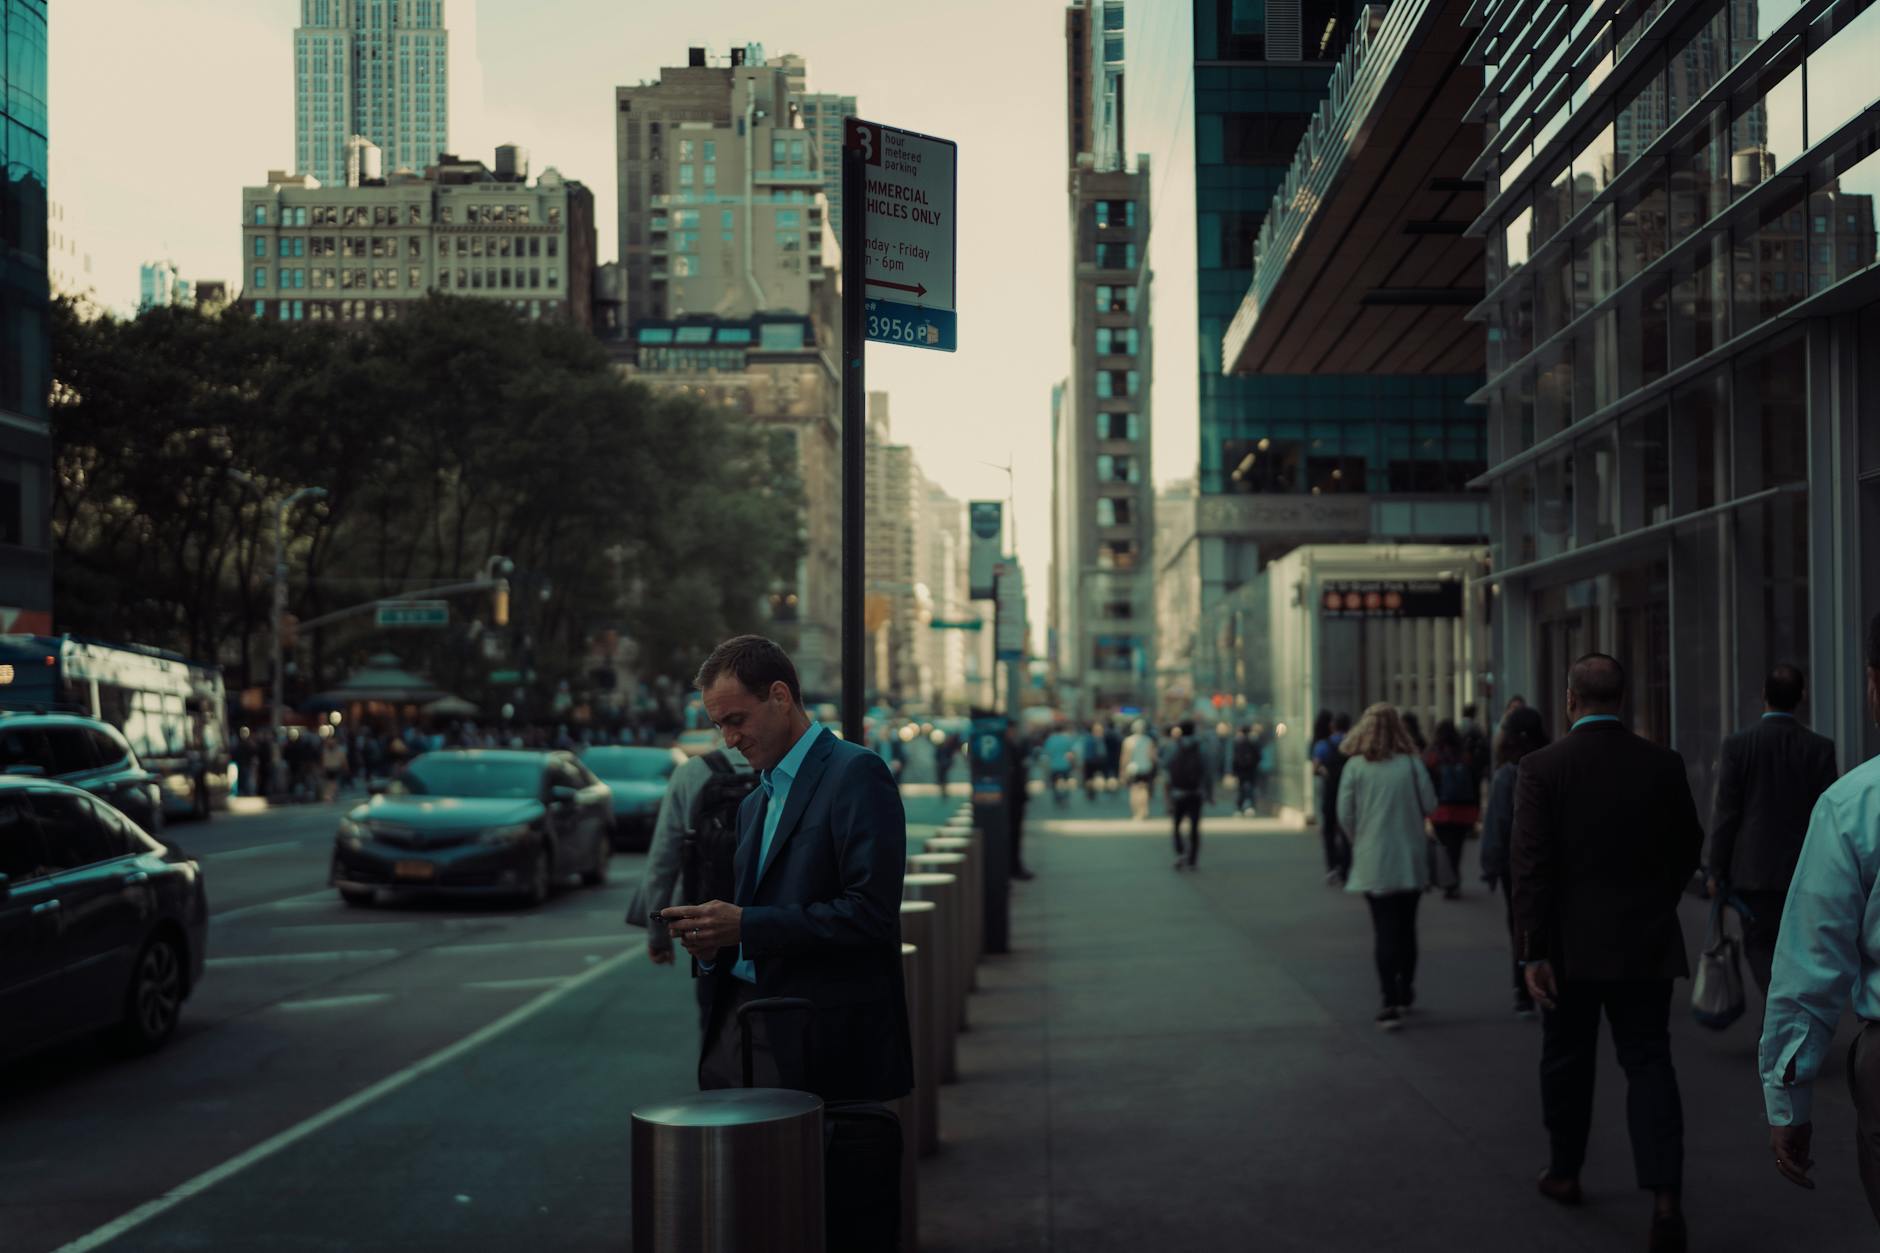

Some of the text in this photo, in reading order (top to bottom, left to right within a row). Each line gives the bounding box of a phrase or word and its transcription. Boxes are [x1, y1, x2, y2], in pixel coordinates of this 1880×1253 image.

[855, 126, 872, 161] 3
[885, 133, 904, 147] hour
[885, 147, 921, 163] metered
[885, 160, 917, 177] parking
[864, 180, 929, 206] MMERCIAL
[867, 198, 941, 226] HICLES ONLY
[864, 237, 890, 255] nday
[899, 242, 930, 262] Friday
[882, 256, 904, 271] 6pm
[869, 316, 914, 341] 3956
